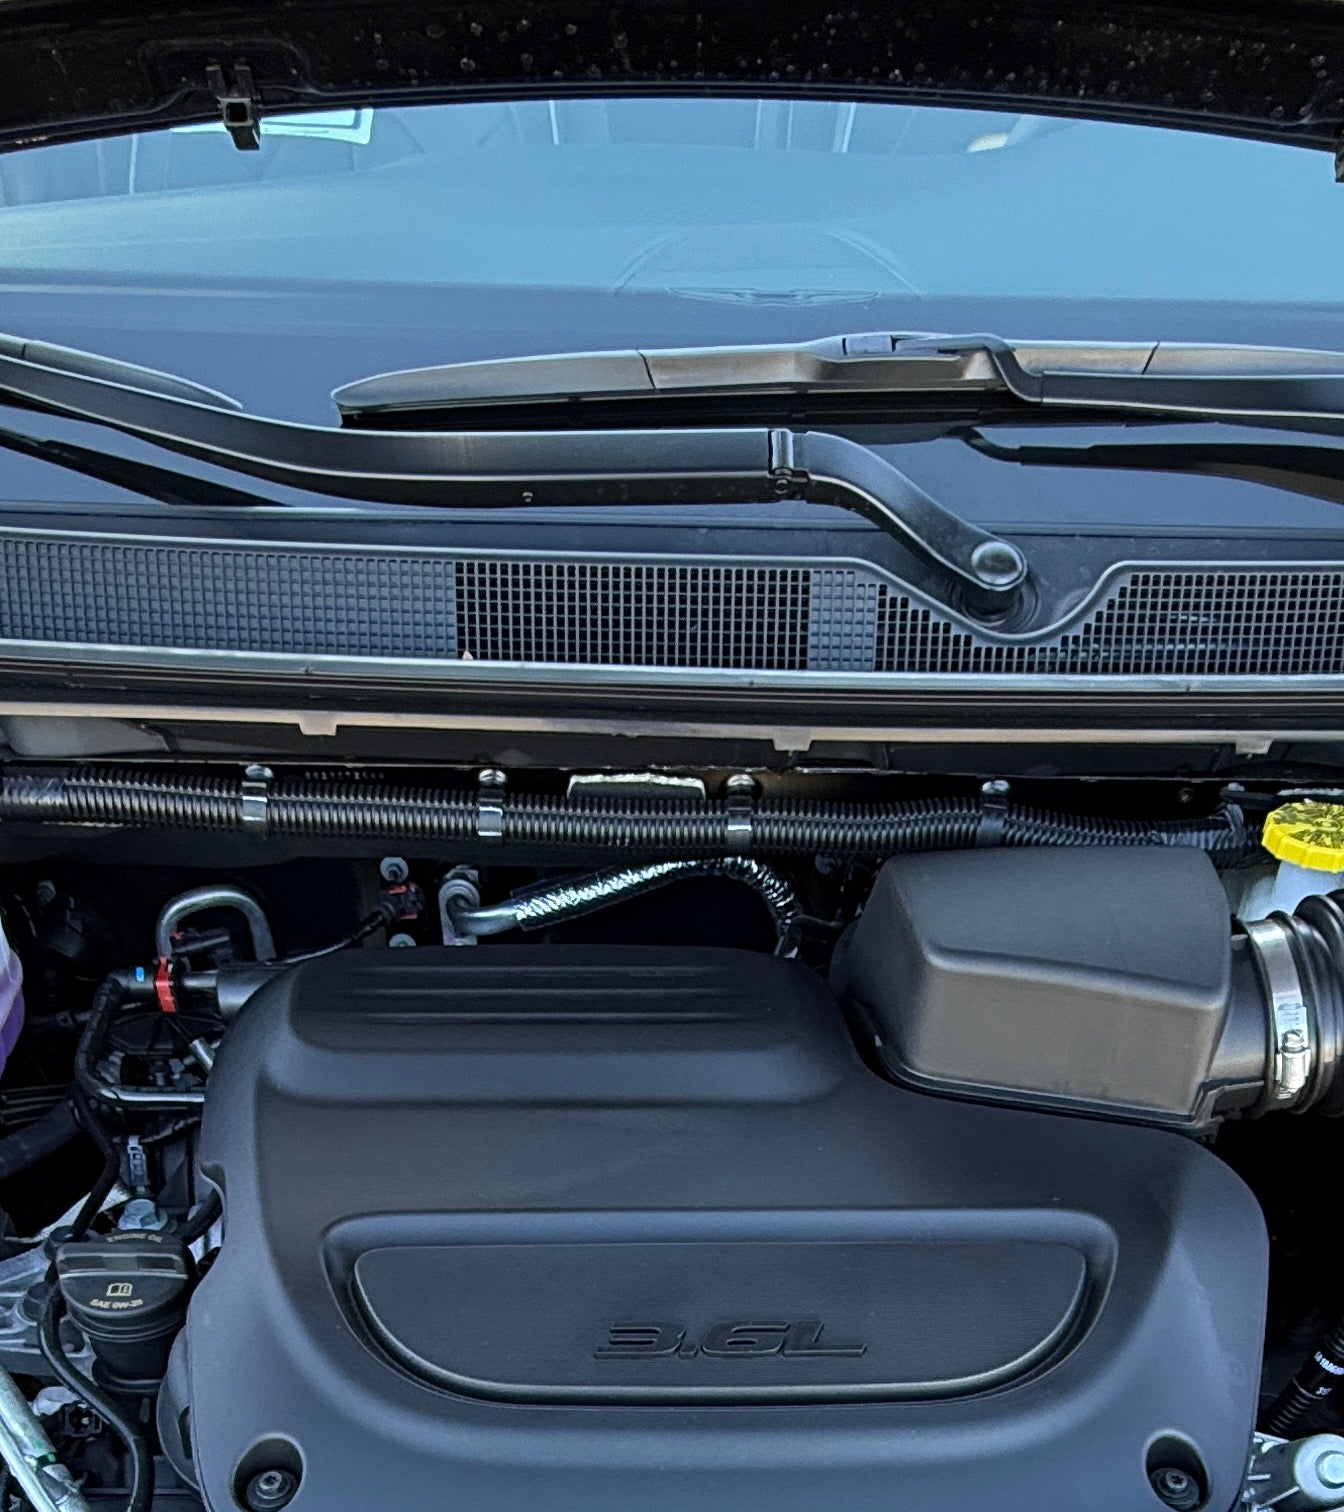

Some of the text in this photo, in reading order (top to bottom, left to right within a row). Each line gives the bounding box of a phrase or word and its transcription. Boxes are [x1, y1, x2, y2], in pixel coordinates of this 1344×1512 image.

[107, 1233, 163, 1243] ENGINE OIL
[90, 1299, 144, 1309] SAE 0W-20
[594, 1320, 867, 1359] 3.6L
